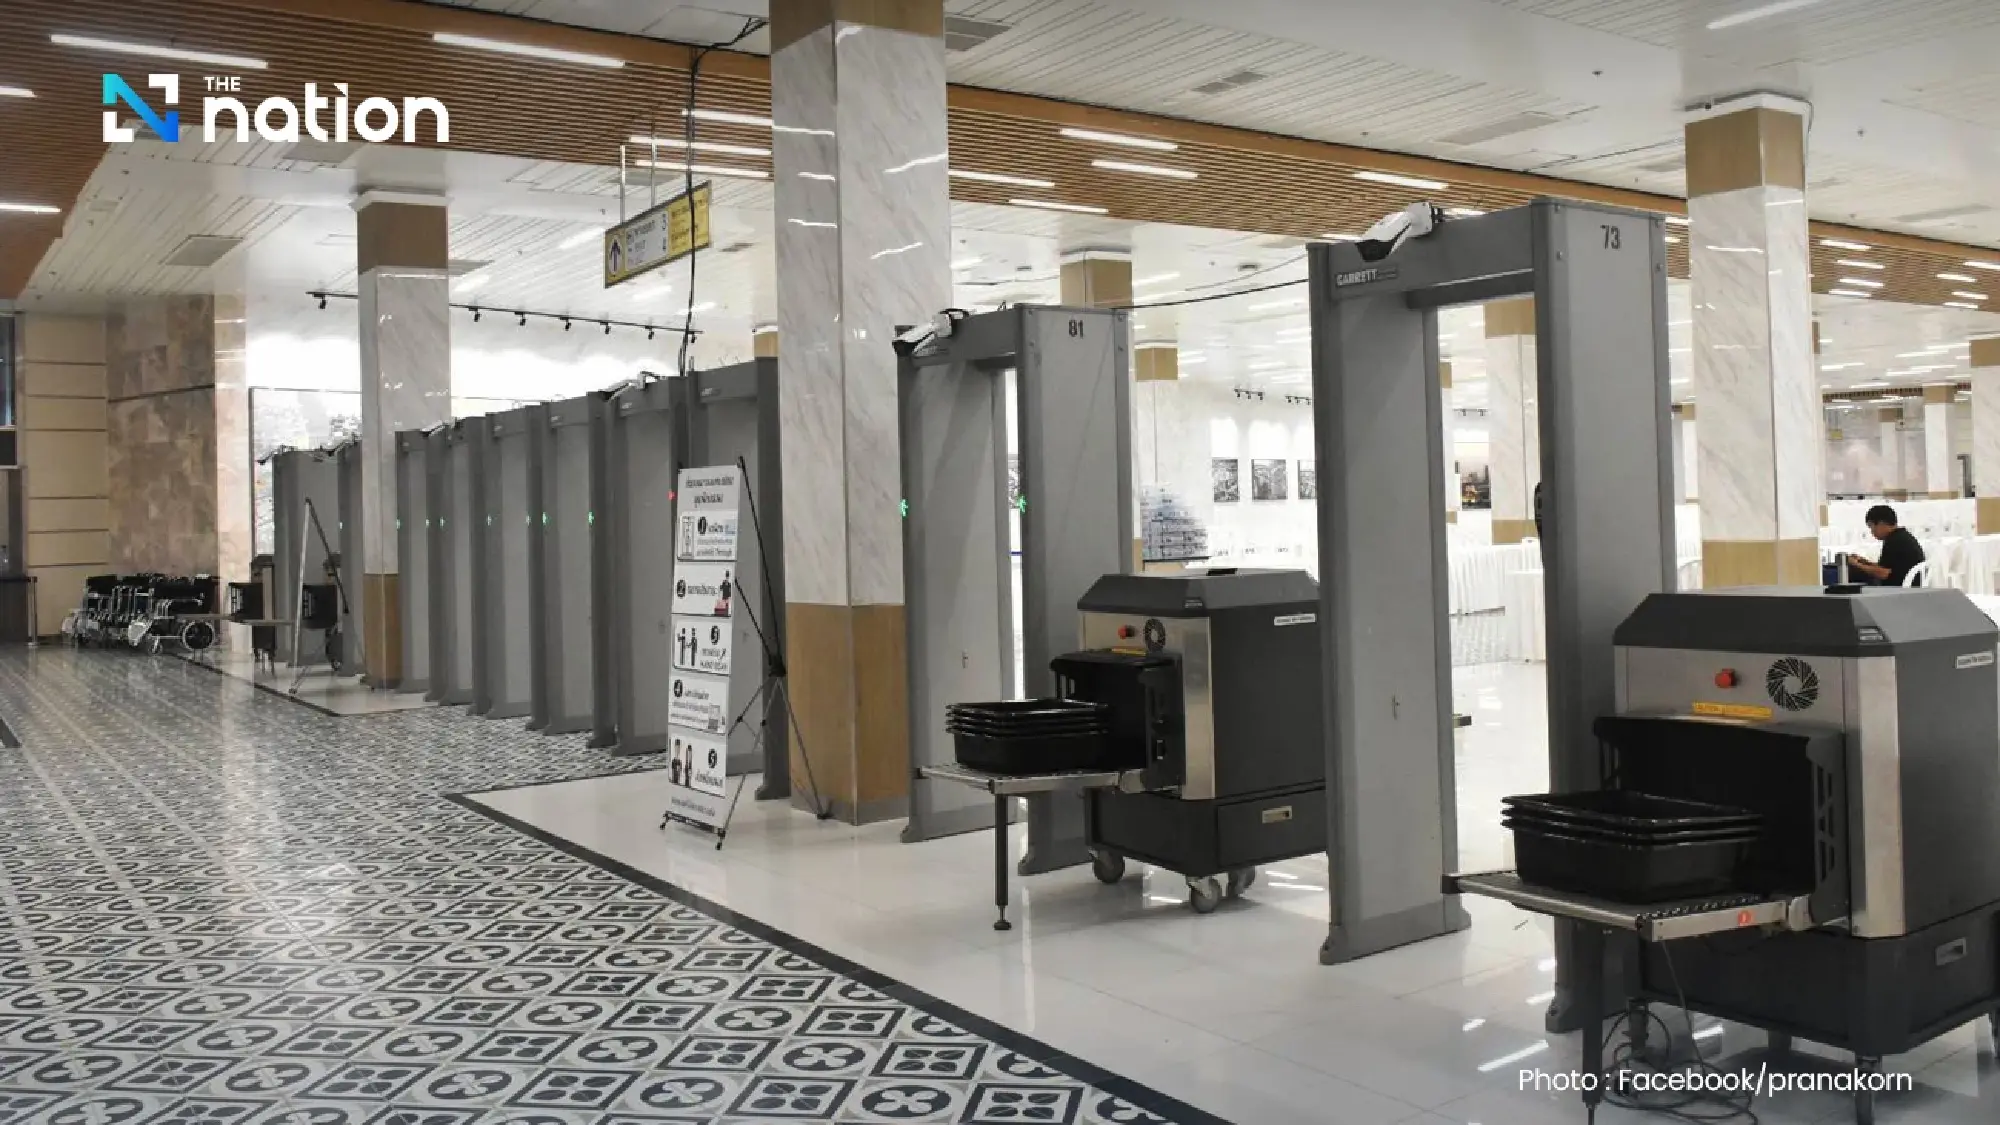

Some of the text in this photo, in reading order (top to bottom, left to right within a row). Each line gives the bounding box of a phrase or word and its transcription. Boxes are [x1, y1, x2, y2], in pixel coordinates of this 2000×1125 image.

[1600, 225, 1621, 249] 73
[1336, 268, 1377, 286] GARRETT
[1068, 319, 1084, 338] 81
